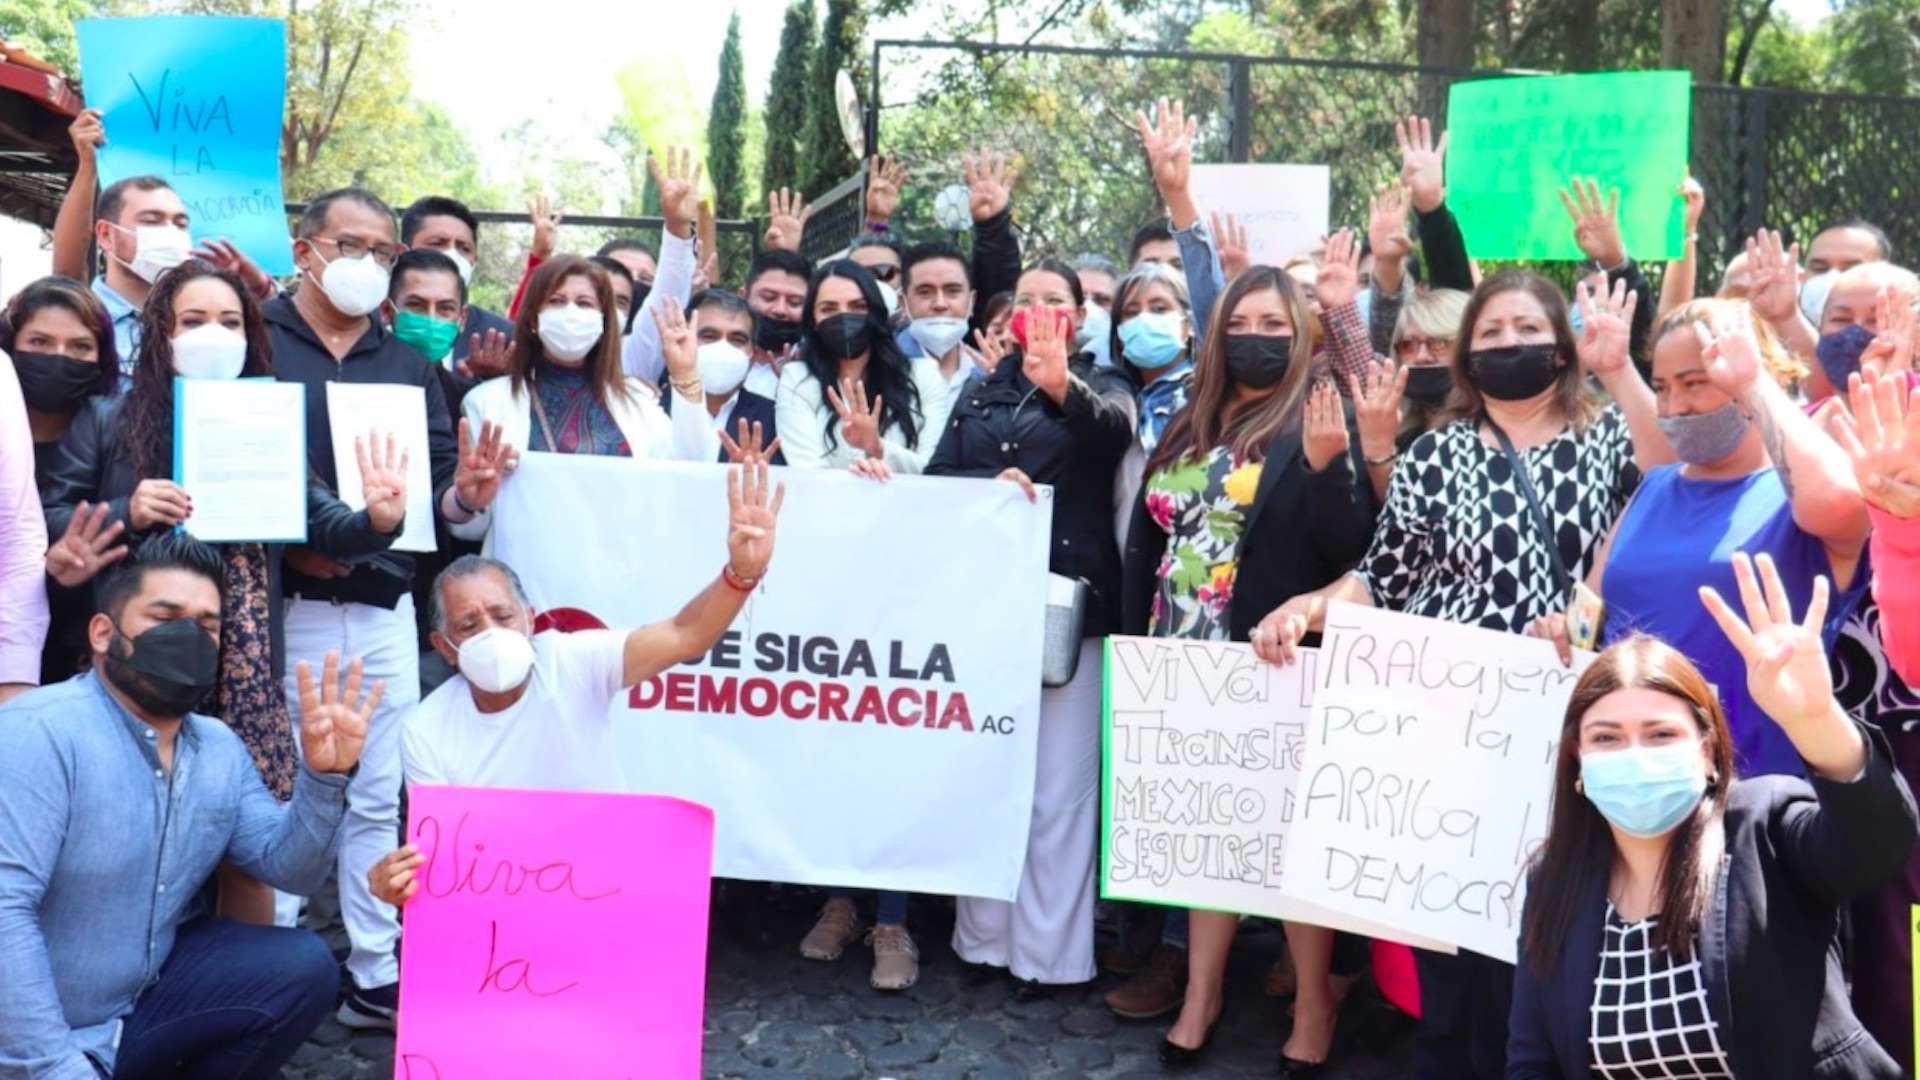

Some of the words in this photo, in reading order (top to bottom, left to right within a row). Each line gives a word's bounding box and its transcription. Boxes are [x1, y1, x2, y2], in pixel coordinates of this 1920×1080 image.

[172, 144, 217, 176] LA
[754, 632, 878, 678] SIGA
[888, 639, 956, 683] LA
[628, 672, 975, 732] DEMOCRACIA
[980, 714, 1015, 735] AC
[1465, 709, 1512, 757] la
[1113, 775, 1266, 826] MEXICO
[417, 812, 622, 900] Viva
[1325, 846, 1515, 929] DEMOCR
[479, 919, 579, 997] la
